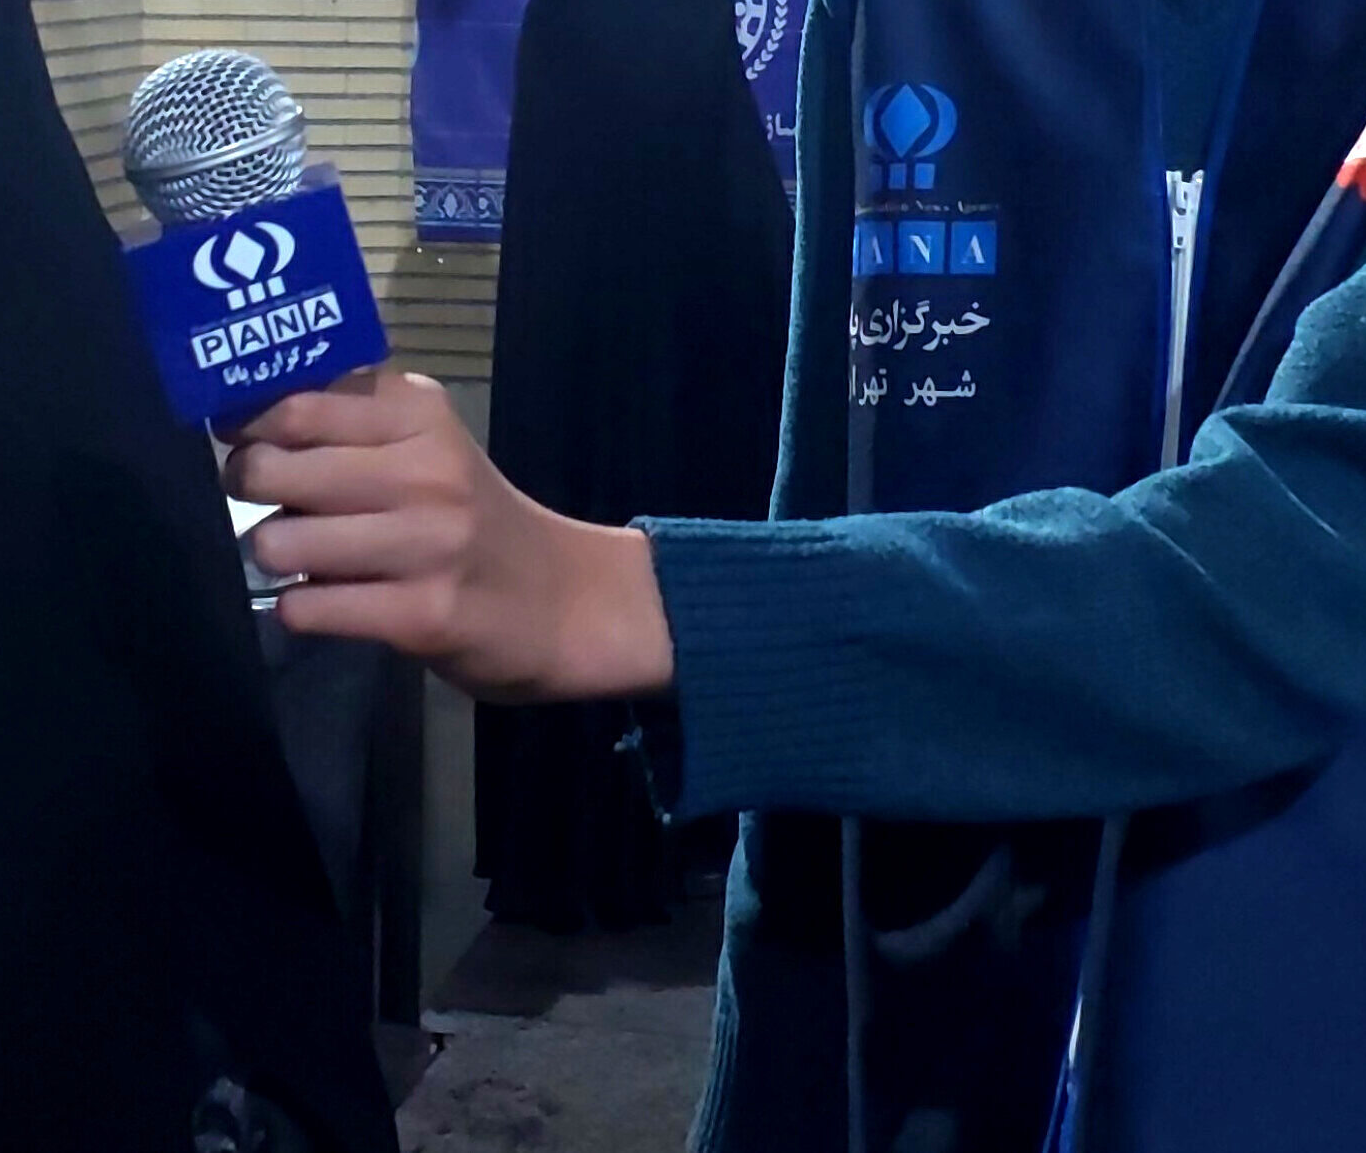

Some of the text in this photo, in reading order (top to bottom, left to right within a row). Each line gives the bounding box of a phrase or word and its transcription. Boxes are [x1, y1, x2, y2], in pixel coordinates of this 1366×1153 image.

[196, 297, 340, 366] PANA
[860, 299, 991, 350] خبرگزاری
[848, 364, 977, 407] شهر تهرا
